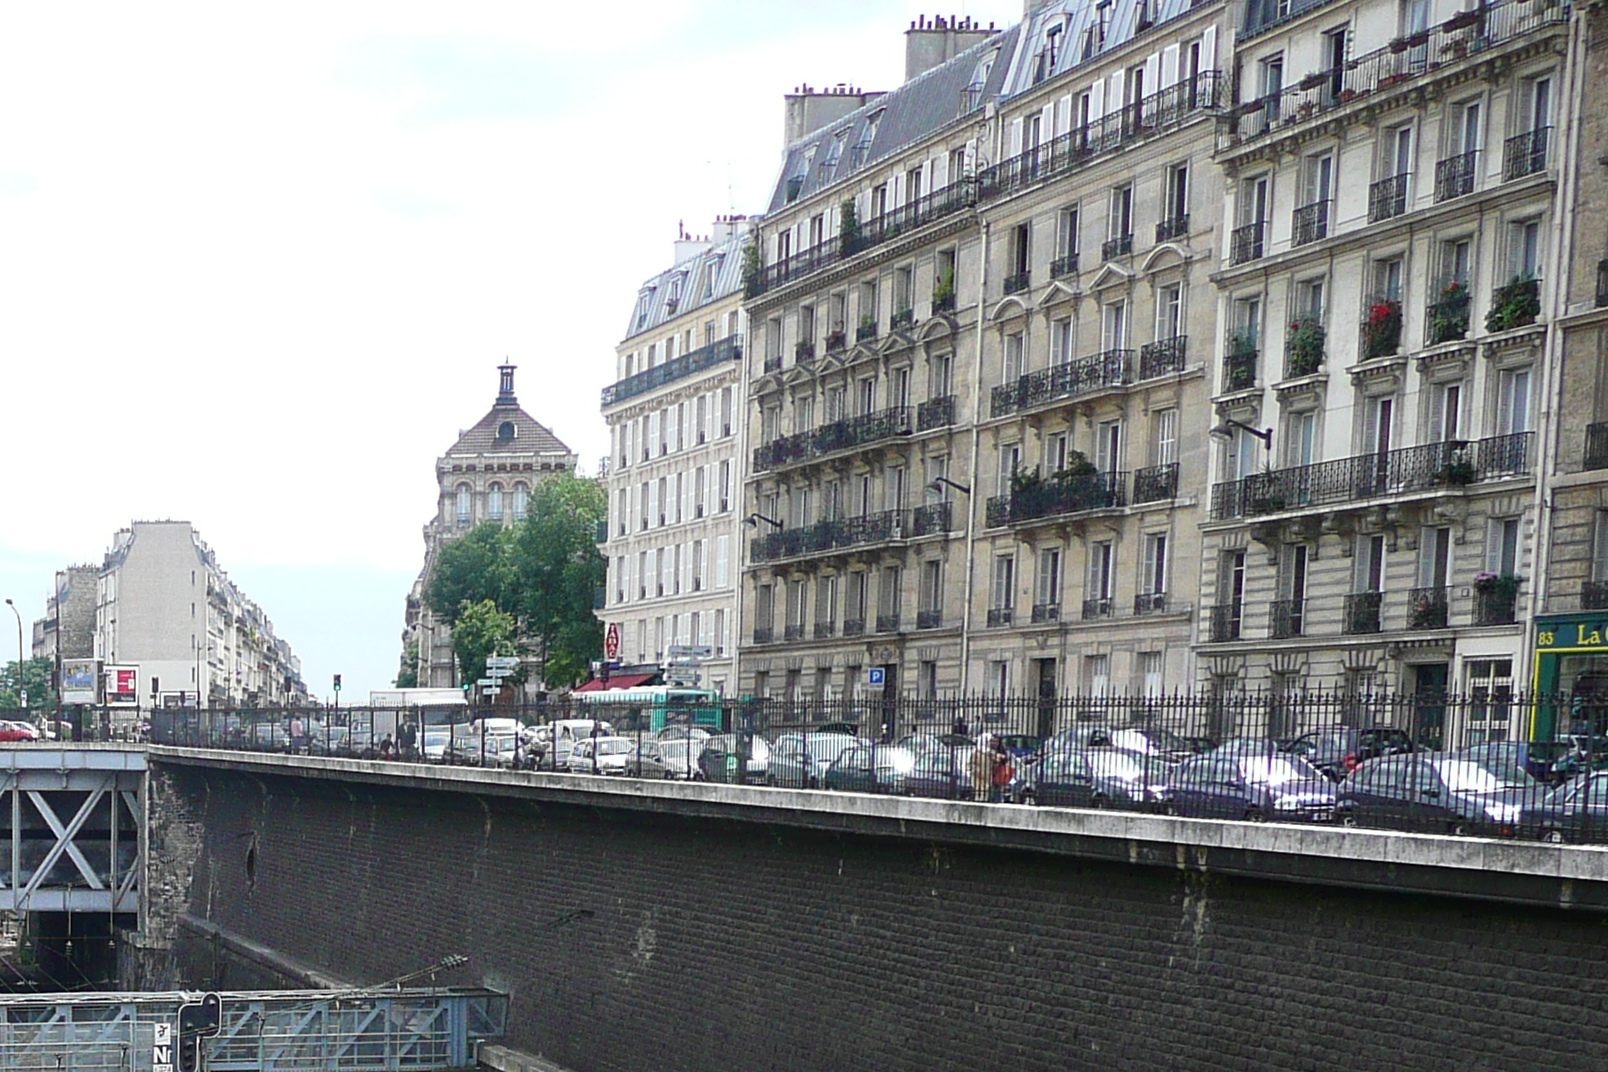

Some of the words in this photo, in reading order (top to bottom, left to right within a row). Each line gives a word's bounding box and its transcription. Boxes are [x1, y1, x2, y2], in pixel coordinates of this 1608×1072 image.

[608, 625, 617, 657] TABAC
[1538, 631, 1554, 645] 83
[1577, 624, 1601, 645] La
[872, 671, 881, 682] P
